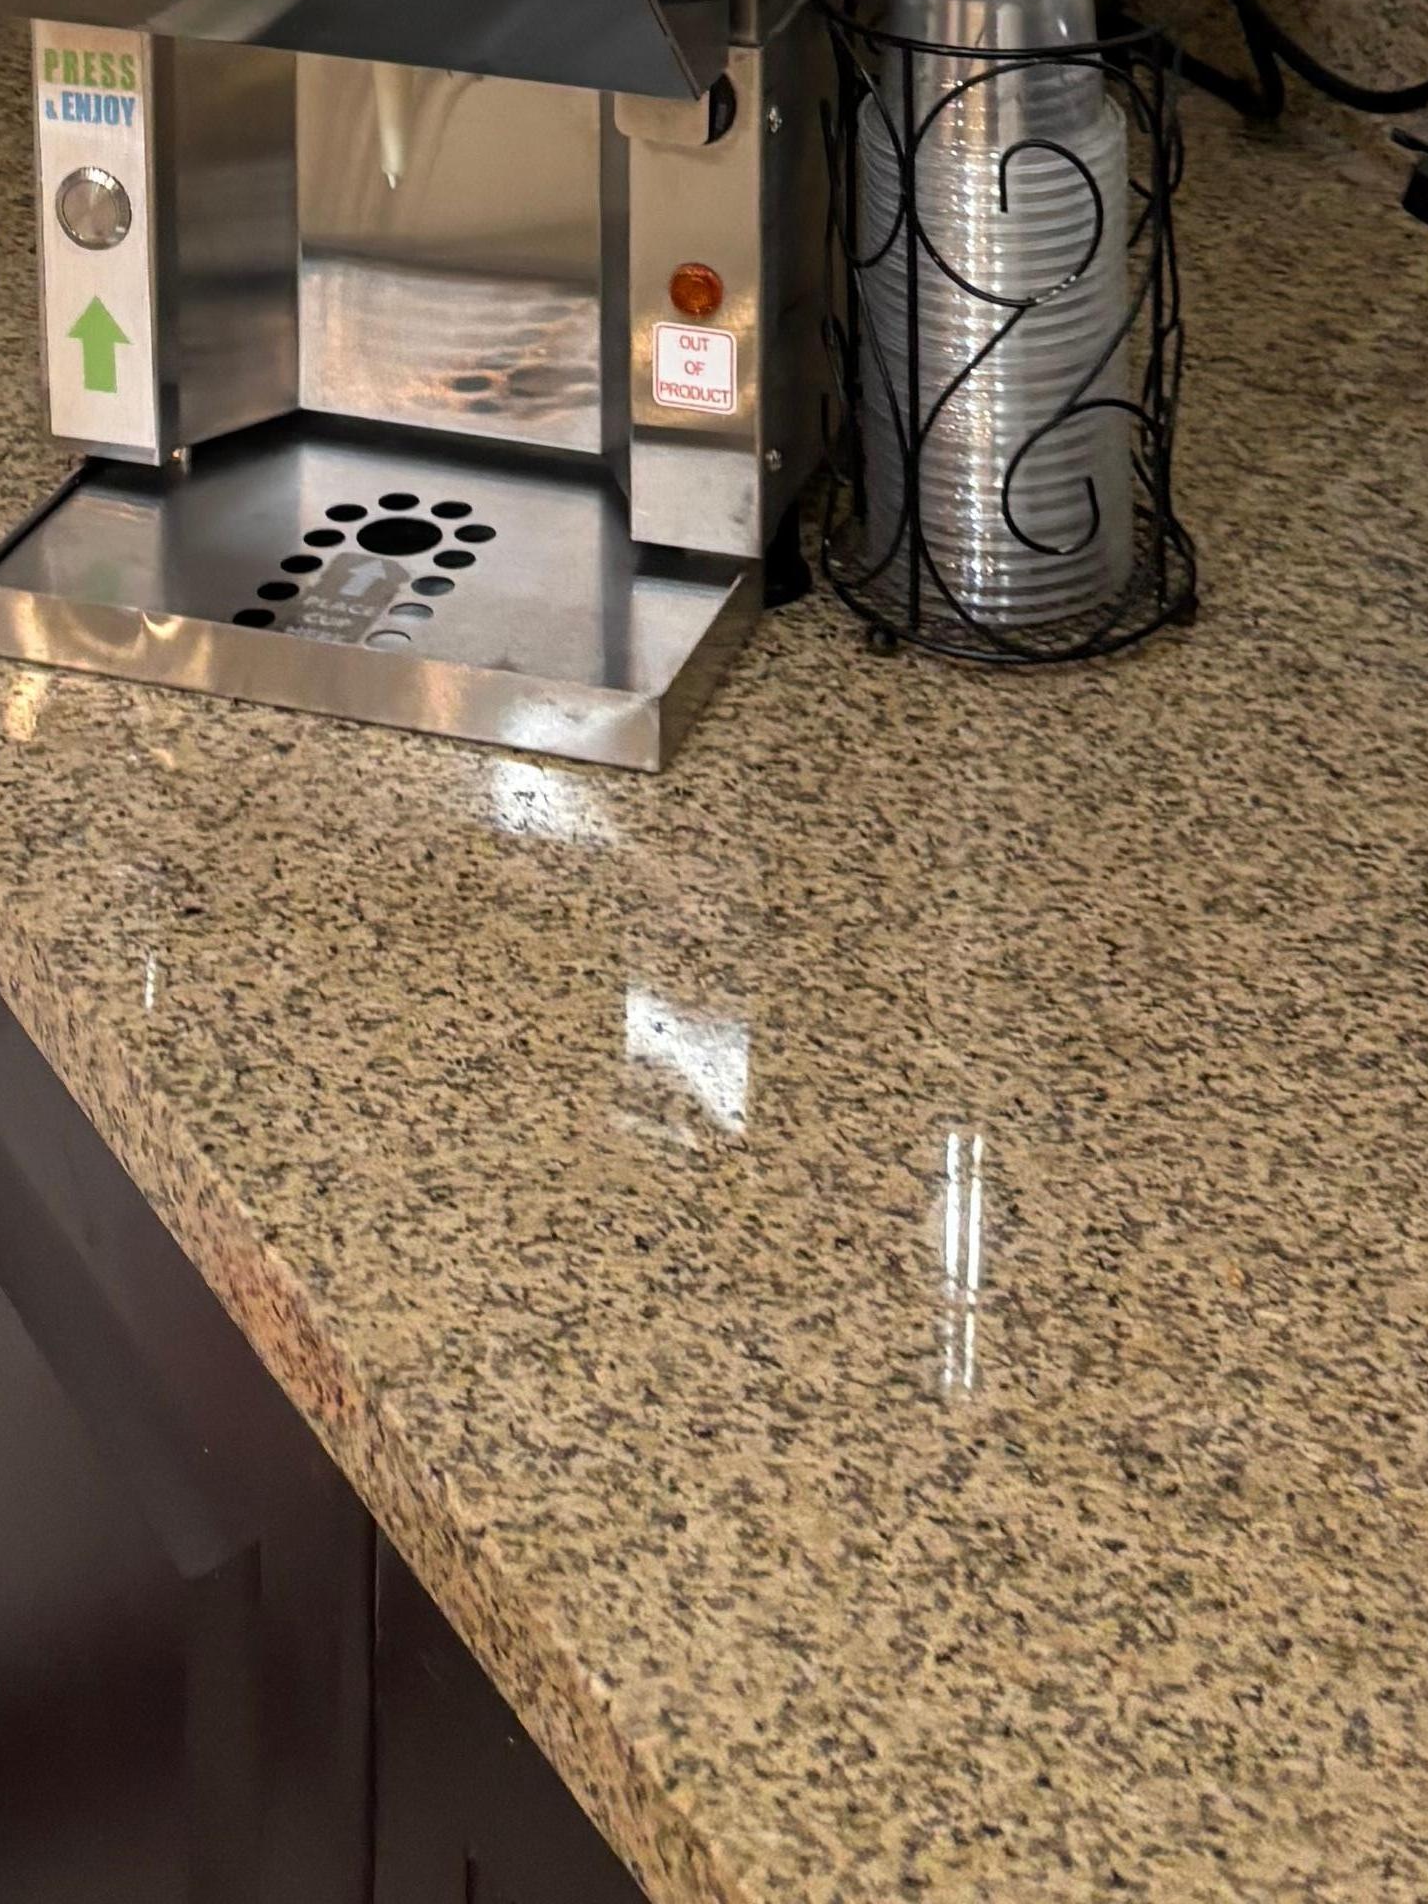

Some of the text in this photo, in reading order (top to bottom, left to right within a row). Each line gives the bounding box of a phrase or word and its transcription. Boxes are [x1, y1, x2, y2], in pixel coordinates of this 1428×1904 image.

[44, 48, 135, 90] PRESS
[61, 90, 135, 127] ENJOY
[679, 335, 710, 351] OUT
[684, 360, 706, 376] OF
[659, 381, 730, 403] PRODUCT
